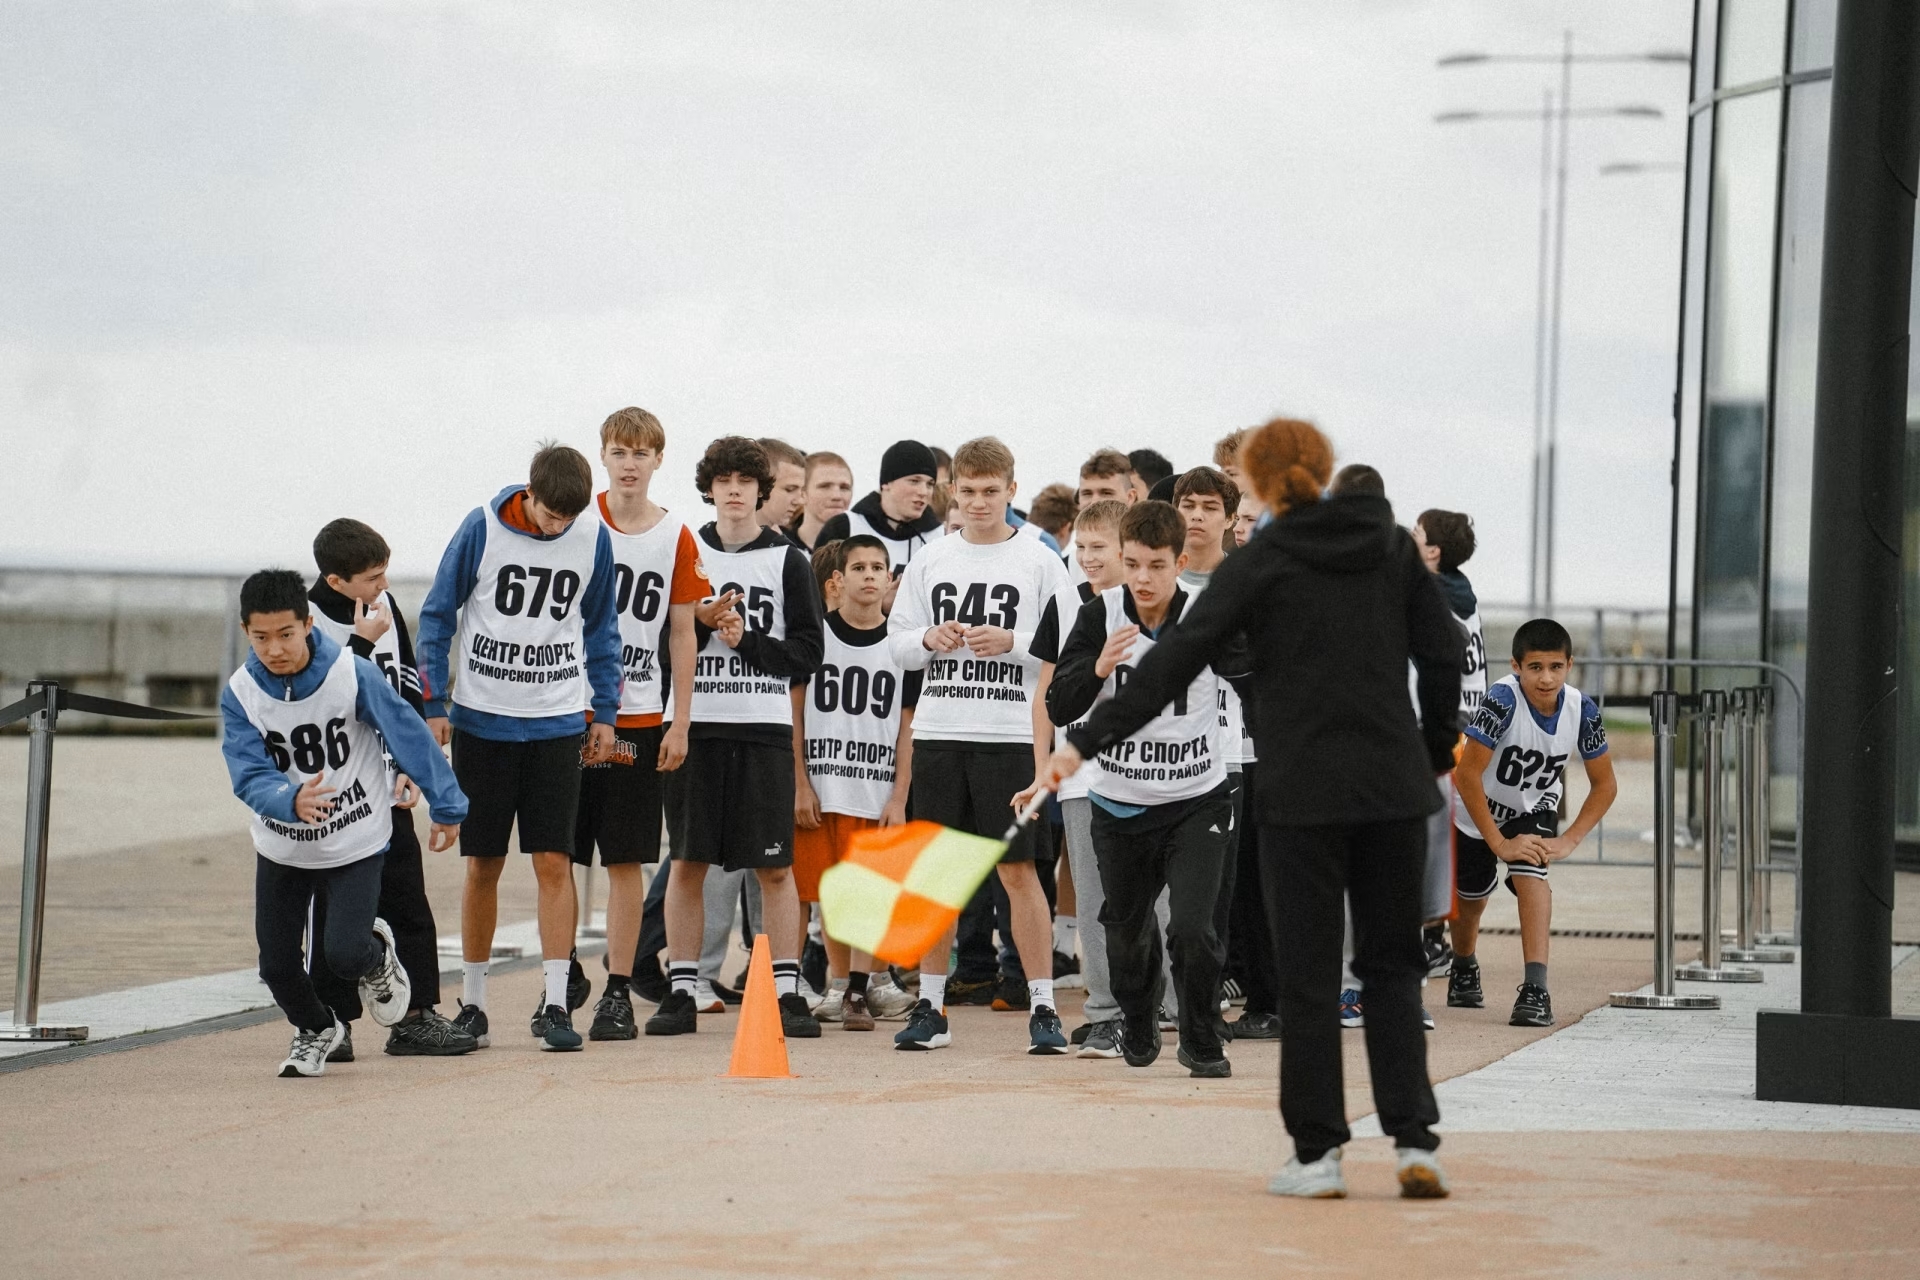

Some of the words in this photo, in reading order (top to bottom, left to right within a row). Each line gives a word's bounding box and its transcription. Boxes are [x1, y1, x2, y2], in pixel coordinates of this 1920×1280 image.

[495, 564, 580, 621] 679
[614, 563, 665, 622] 06
[931, 582, 1020, 630] 643
[471, 633, 521, 665] ЦЕНТР
[523, 642, 576, 666] СПОРТА
[622, 644, 654, 669] ОРТА
[468, 658, 545, 684] ПРИМОРСКОГО
[547, 665, 580, 683] РАЙОНА
[694, 655, 725, 677] НТР
[962, 660, 1024, 686] СПОРТА
[692, 681, 752, 694] МОРСКОГО
[754, 680, 787, 695] РАЙОНА
[814, 663, 896, 719] 609
[987, 686, 1027, 702] РАЙОНА
[1462, 690, 1484, 707] НТР
[264, 717, 351, 774] 686
[1140, 735, 1210, 764] СПОРТА
[807, 763, 865, 779] РИМОРСКОГО
[866, 768, 896, 783] РАЙОН
[1098, 757, 1165, 780] МОРСКОГО
[1169, 758, 1212, 780] РАЙОНА
[1496, 745, 1568, 791] 625
[329, 802, 373, 833] РАЙОНА
[1485, 795, 1517, 820] НТР
